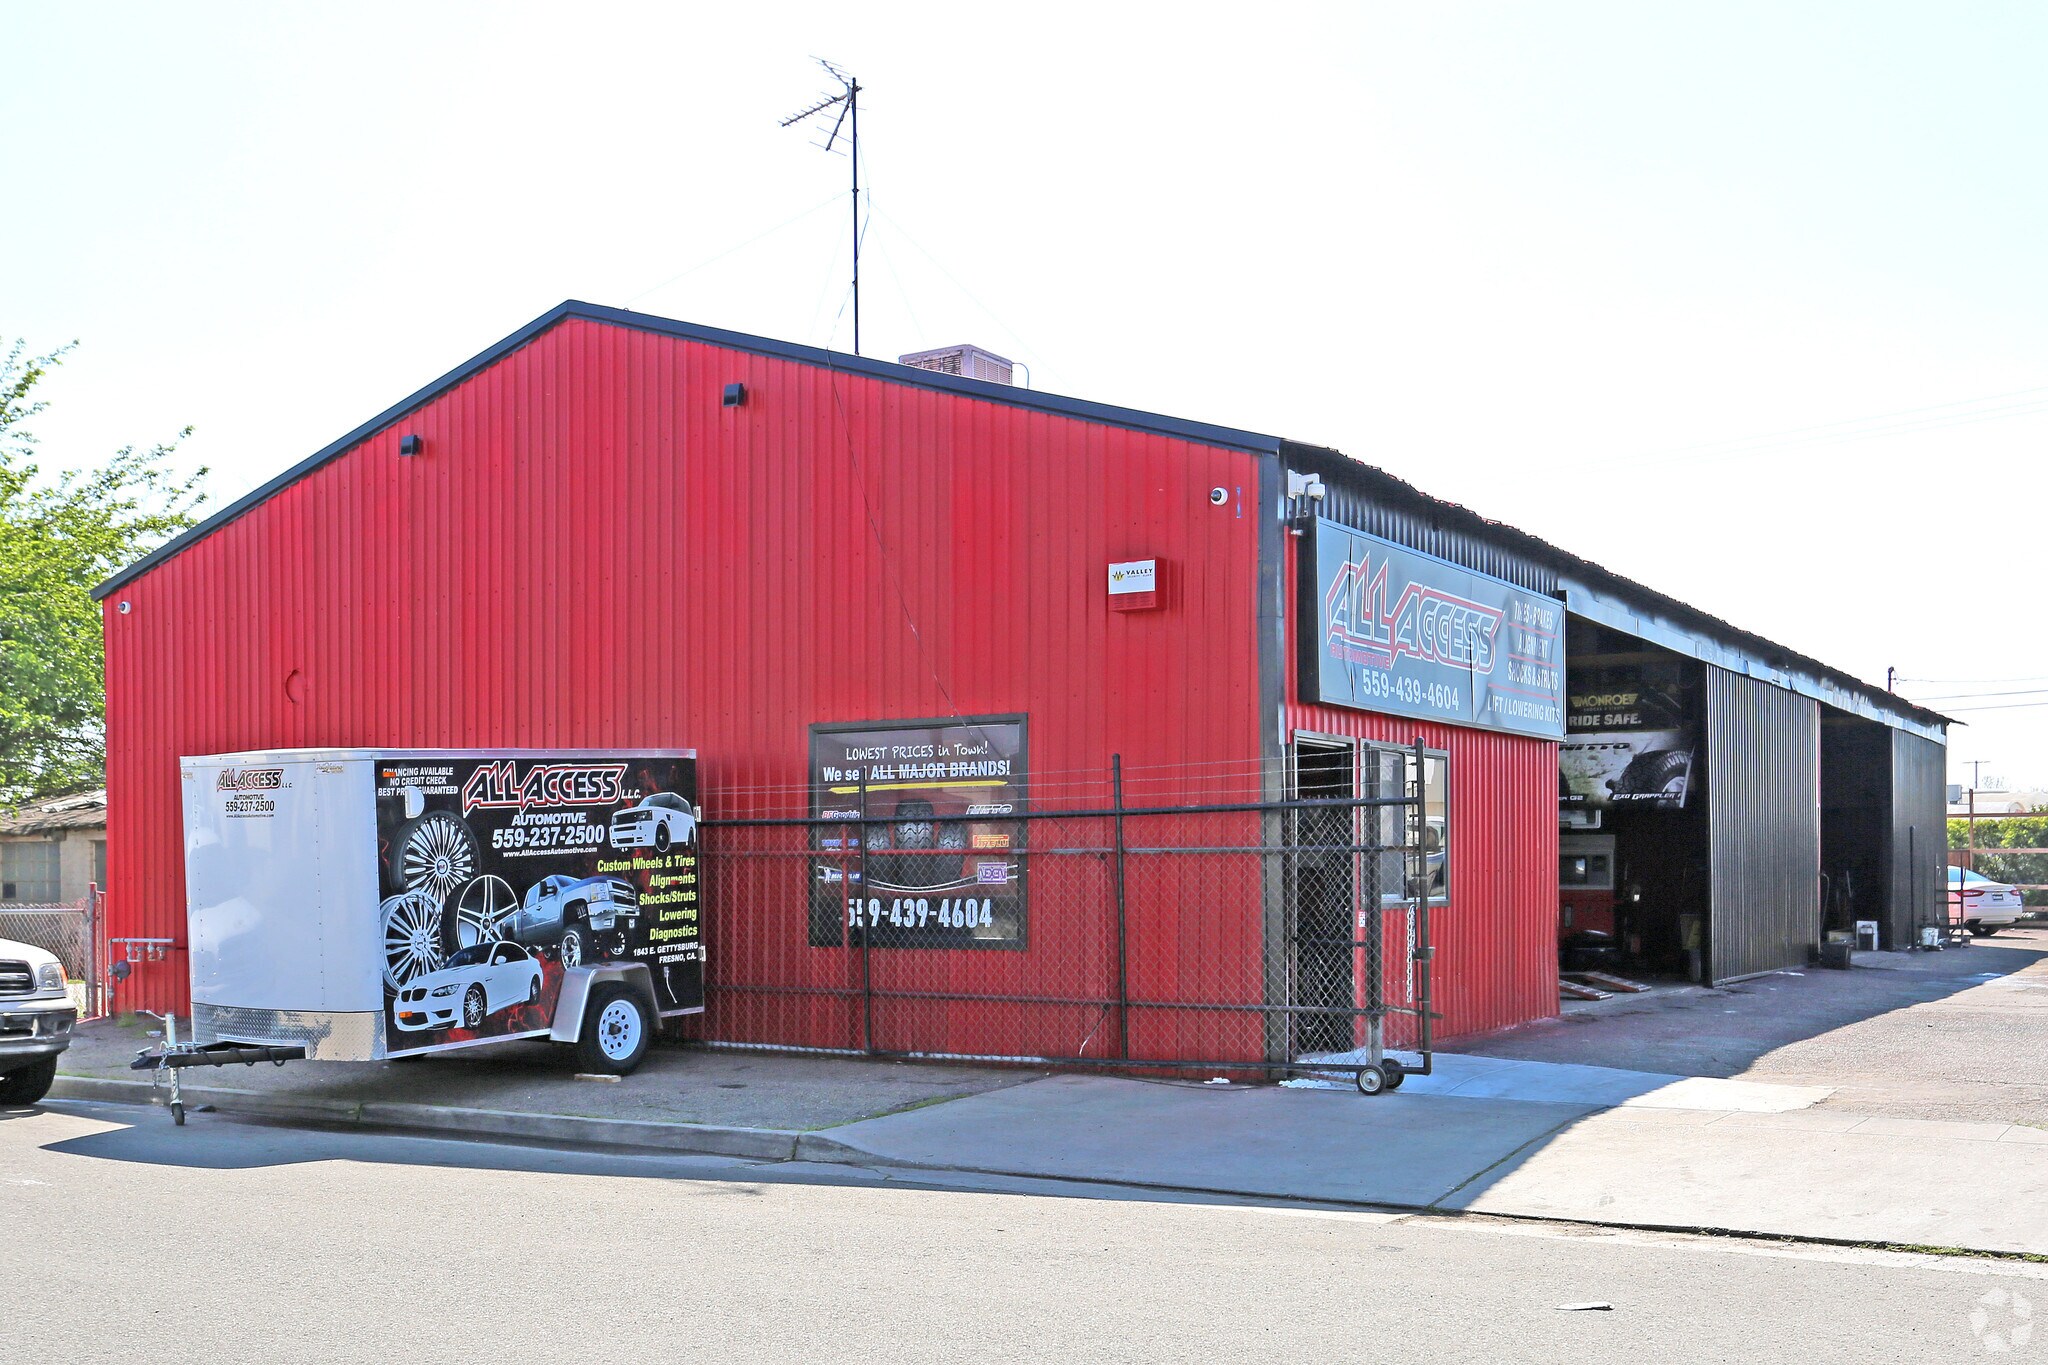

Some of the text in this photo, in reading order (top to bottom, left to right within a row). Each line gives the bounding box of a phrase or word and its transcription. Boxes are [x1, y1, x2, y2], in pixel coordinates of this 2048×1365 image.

[1327, 553, 1504, 673] ALL ACCESS
[1362, 668, 1459, 710] 559-439-4604
[1580, 694, 1630, 706] MONROE
[1508, 699, 1543, 720] LOWERING
[1545, 706, 1560, 723] KITS
[1568, 713, 1642, 726] RIDE SAFE.
[846, 740, 988, 760] LOWEST PRICES in Town!
[420, 767, 453, 775] AVAILABLE
[823, 767, 842, 782] We
[871, 765, 895, 780] ALL
[899, 762, 946, 779] MAJOR
[950, 760, 1011, 777] BRANDS!
[217, 769, 283, 791] ALL ACCESS
[390, 776, 447, 786] NO CREDIT CHECK
[378, 787, 395, 796] BEST
[463, 762, 521, 814] ALL
[521, 764, 627, 810] ACCESS
[225, 801, 275, 812] 559-237-2500
[512, 812, 586, 826] AUTOMOTIVE
[492, 825, 605, 849] 559-237-2500
[503, 847, 597, 858] www.AllAccessAutomotive.com
[597, 855, 695, 872] Custom Wheels & Tires
[639, 890, 697, 905] Shocks/Struts
[660, 907, 697, 921] Lowering
[848, 898, 993, 928] 559-439-4604
[649, 925, 697, 941] Diagnostics
[633, 942, 698, 956] 1843 E. GETTYSBURG
[659, 952, 697, 963] FRESNO, CA.
